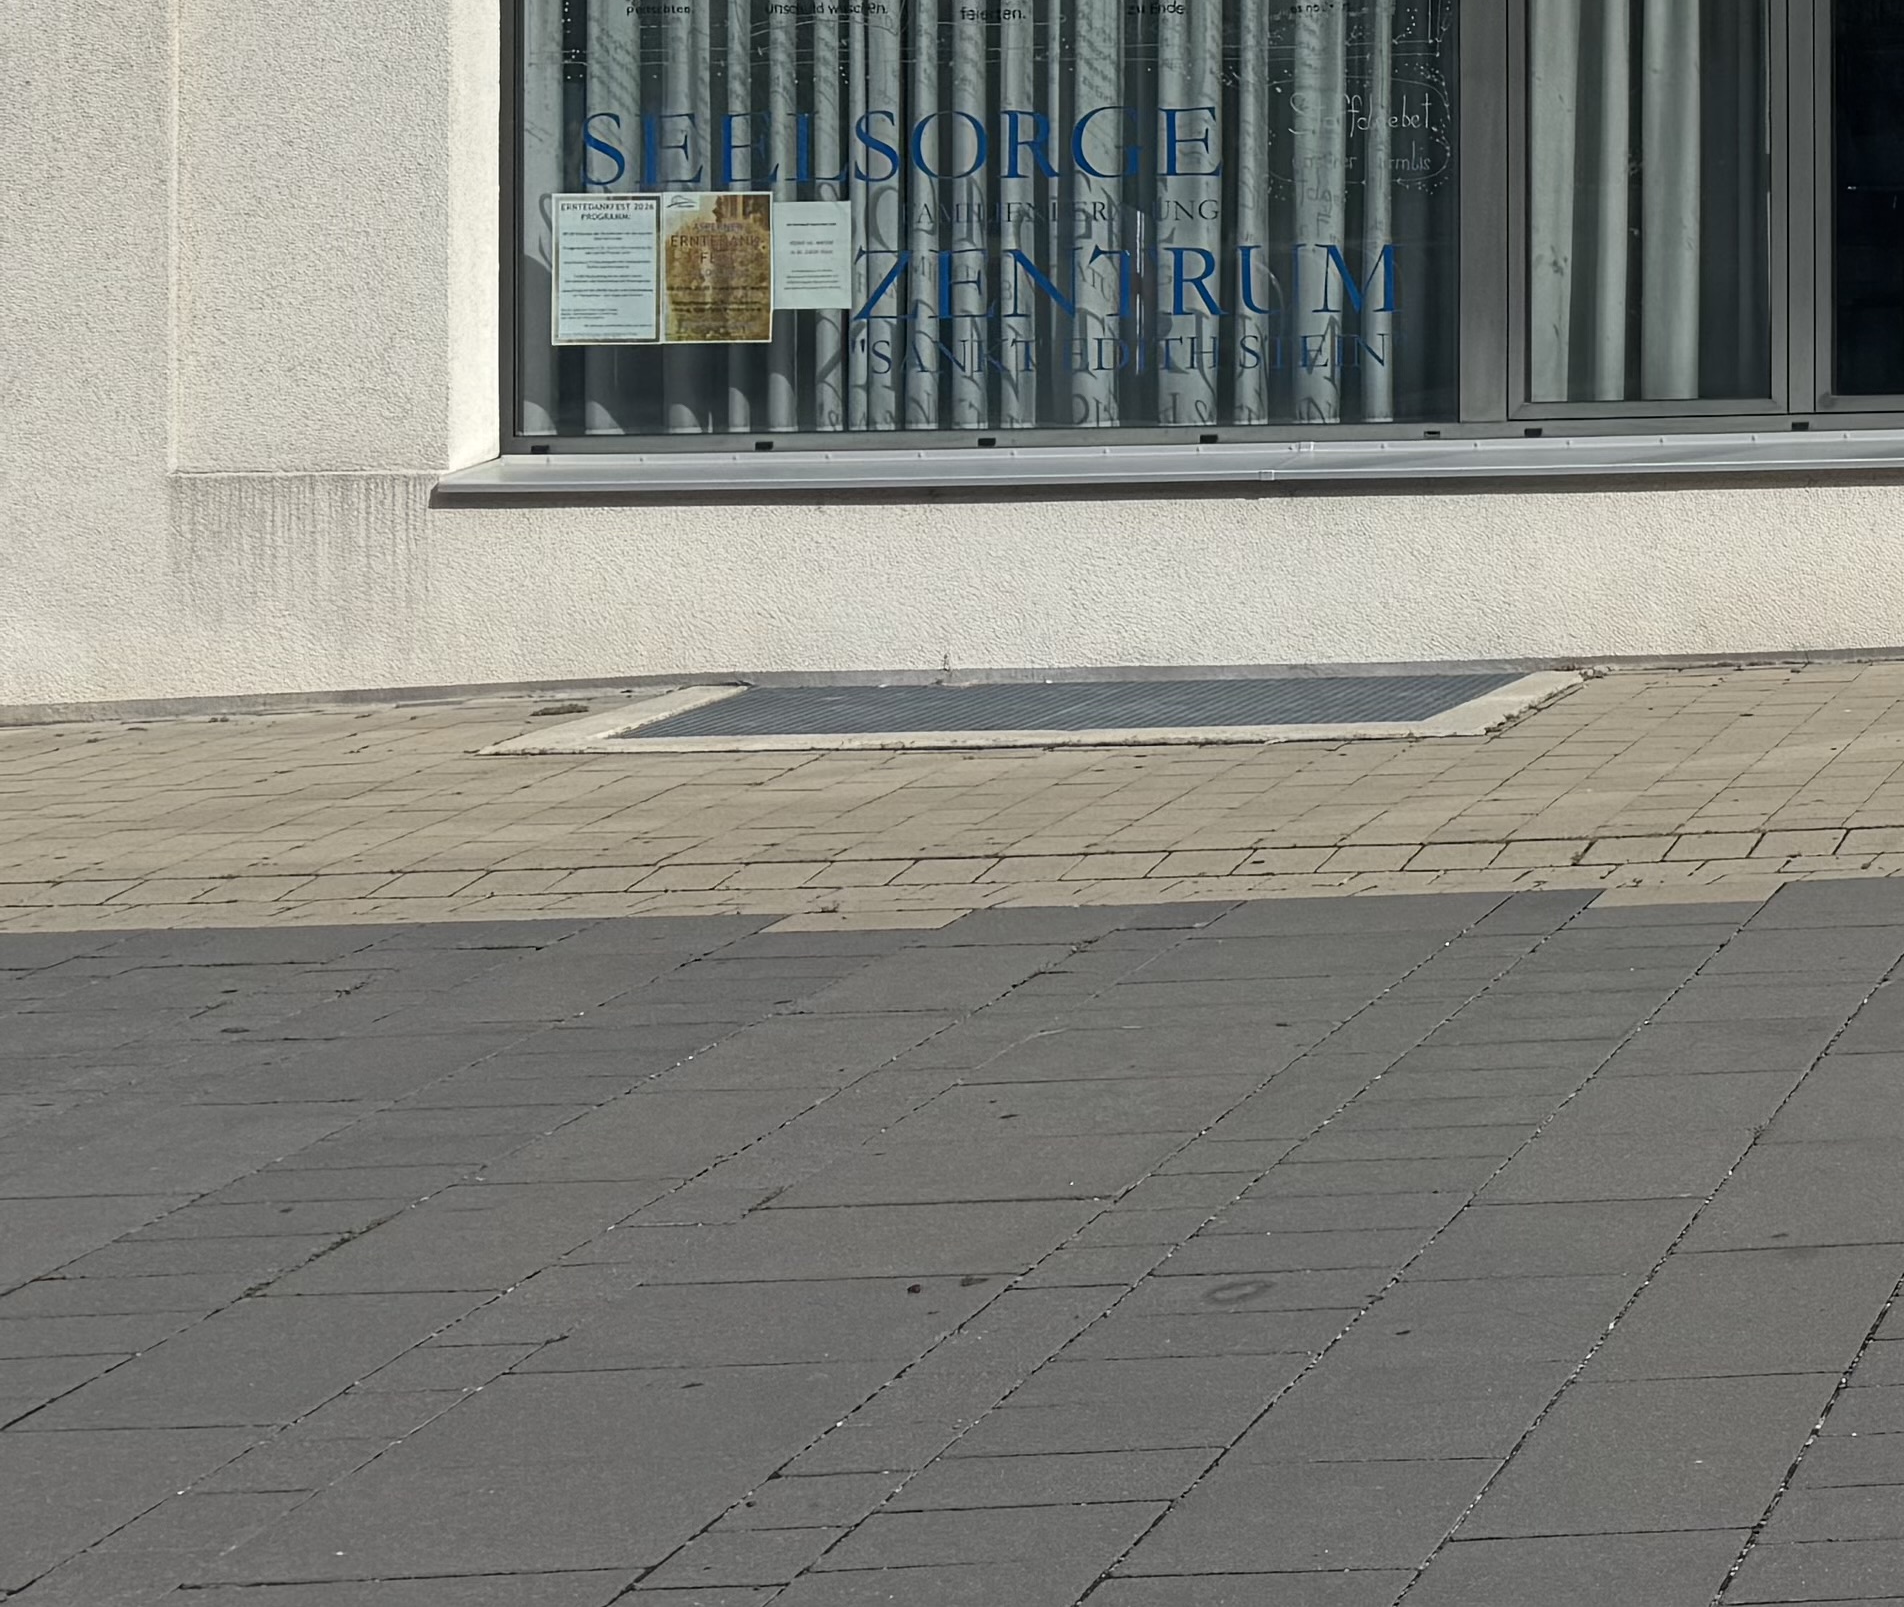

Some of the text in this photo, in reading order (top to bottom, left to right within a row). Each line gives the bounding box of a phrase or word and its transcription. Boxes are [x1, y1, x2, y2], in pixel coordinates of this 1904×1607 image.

[581, 106, 1223, 186] SEELSORGE
[903, 198, 1219, 225] FAMILIENBERAUNG
[853, 244, 1399, 320] ZENTRUM
[1064, 335, 1219, 373] EDITH
